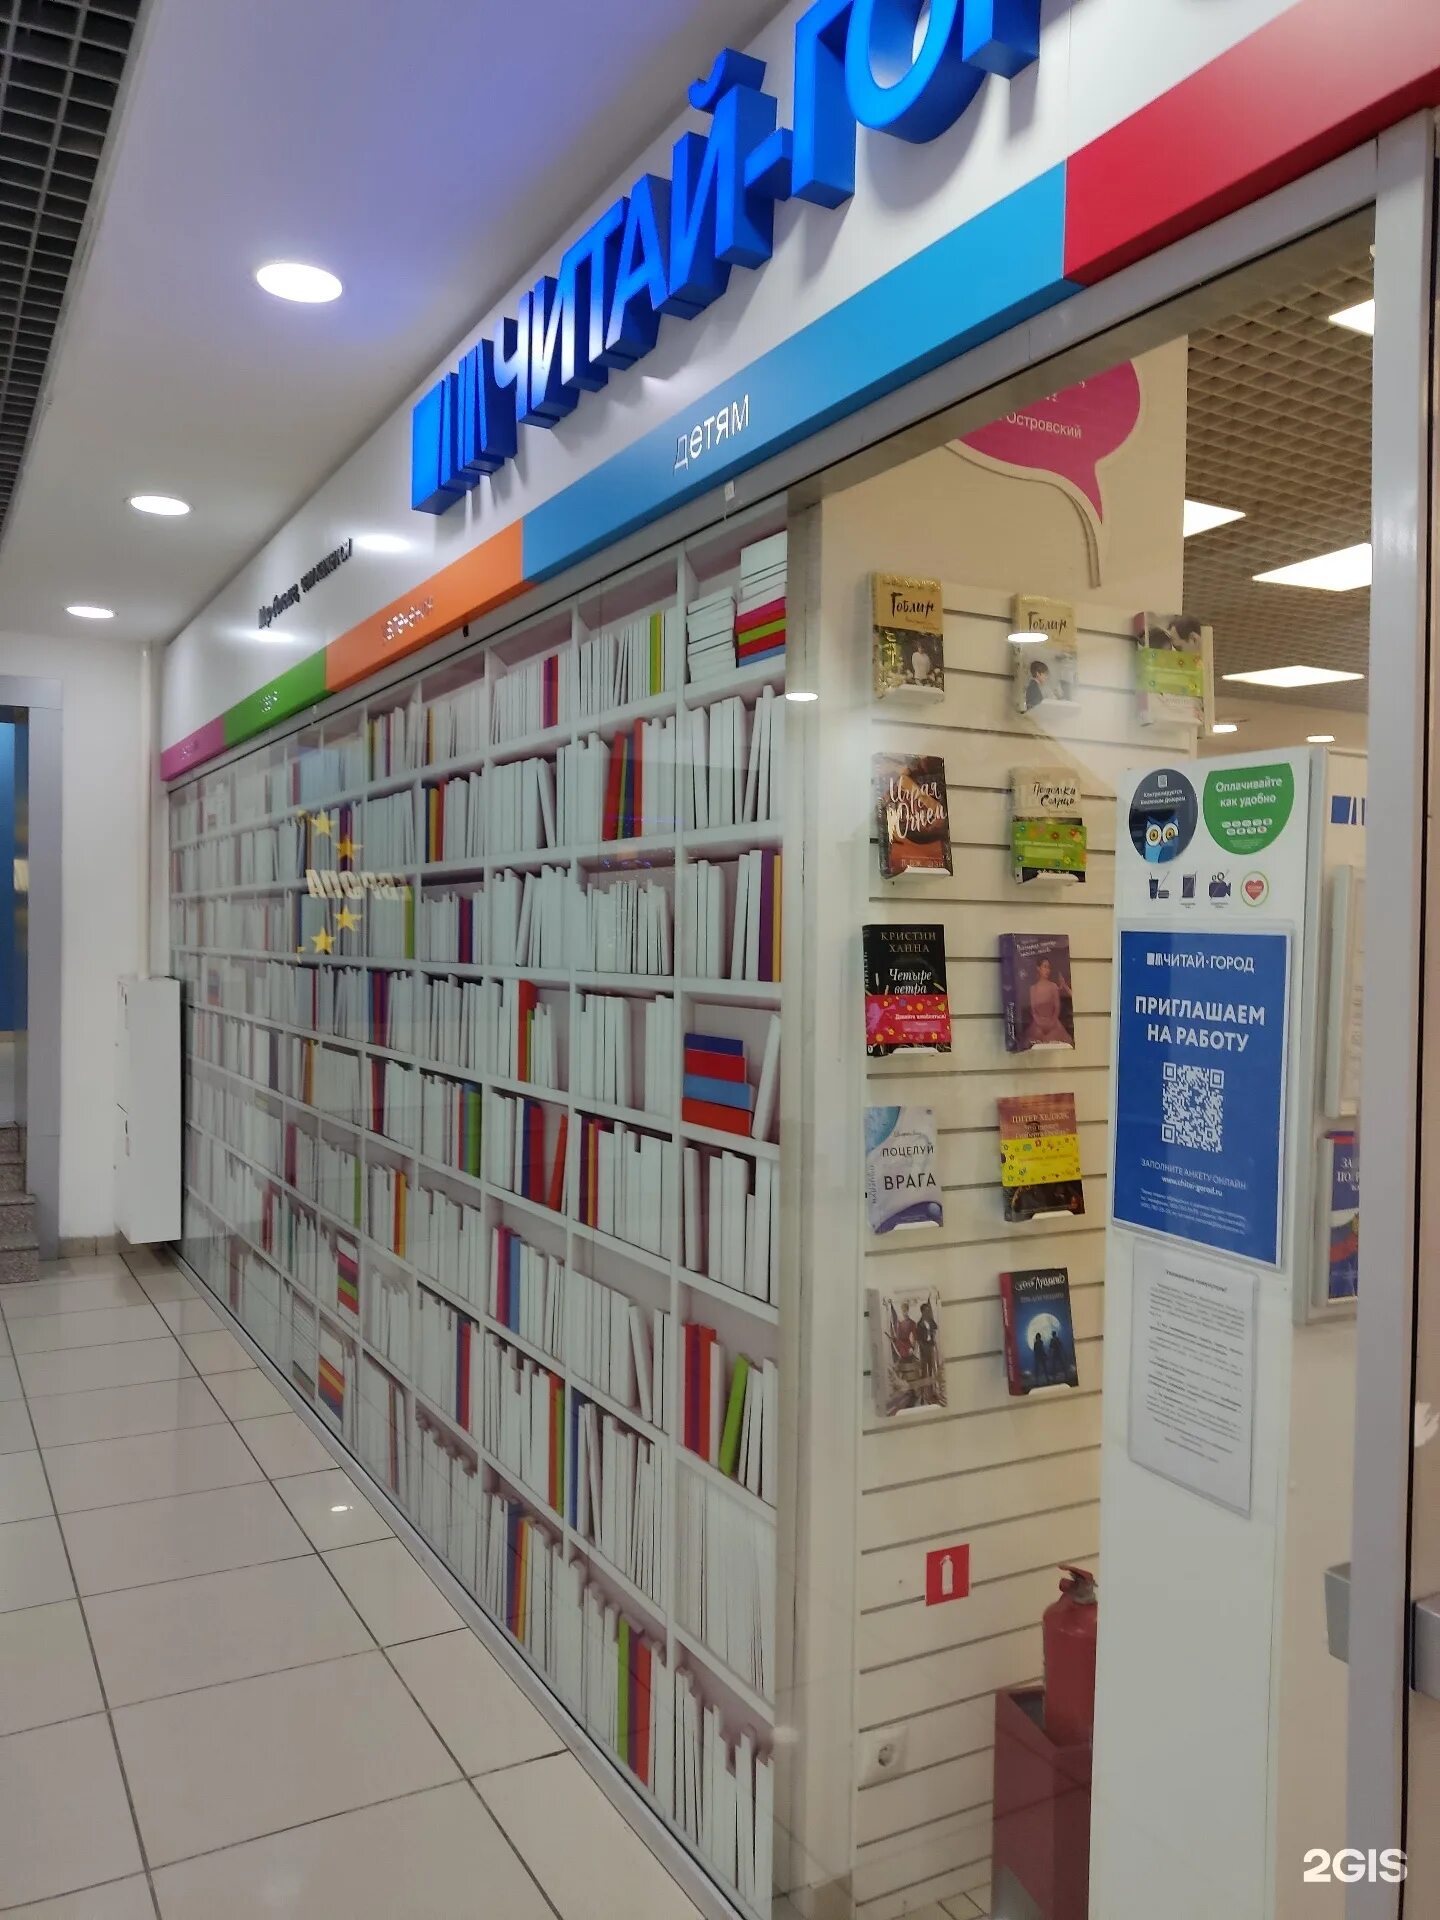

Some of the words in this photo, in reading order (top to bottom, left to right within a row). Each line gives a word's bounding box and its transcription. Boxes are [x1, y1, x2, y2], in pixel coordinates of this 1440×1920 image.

[493, 0, 1038, 428] ЧИТАЙ-ГО
[674, 394, 749, 476] детям
[890, 591, 934, 619] Гоблин
[1028, 611, 1067, 636] Гоблин
[1215, 776, 1283, 793] Оплачивайте
[1220, 797, 1238, 808] как
[1239, 793, 1276, 809] удобно
[881, 931, 936, 941] КРИСТИН
[889, 944, 930, 953] ХАННА
[889, 968, 933, 984] Четыре
[894, 981, 928, 996] ветра
[1135, 995, 1266, 1026] ПРИГЛАШАЕМ
[1147, 1024, 1172, 1044] НА
[1176, 1026, 1250, 1053] РАБОТУ
[882, 1142, 934, 1158] ПОЦЕЛУЙ
[884, 1172, 936, 1190] ВРАГА
[1140, 1158, 1183, 1175] ЗАПОЛНИТЕ
[1184, 1168, 1212, 1183] АНКЕТУ
[1212, 1174, 1247, 1190] ОНЛАЙН
